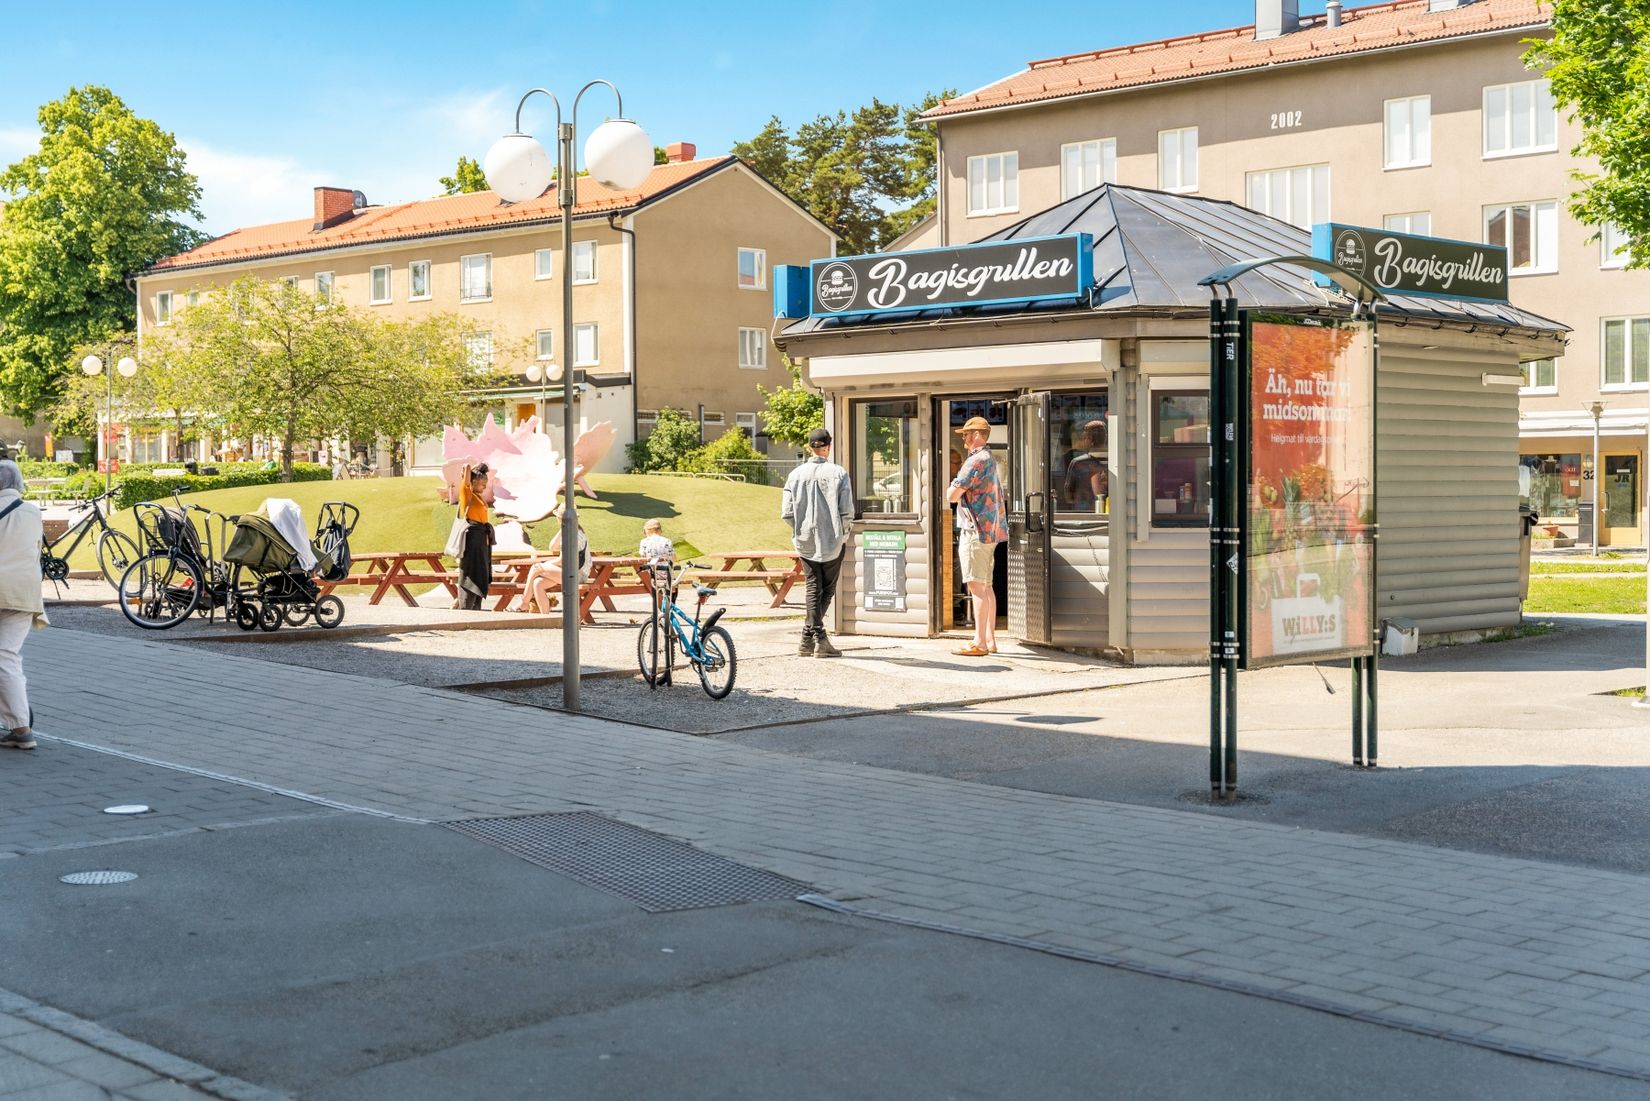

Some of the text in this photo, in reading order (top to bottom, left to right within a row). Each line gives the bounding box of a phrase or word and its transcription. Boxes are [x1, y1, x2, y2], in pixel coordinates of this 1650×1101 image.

[1271, 110, 1302, 129] 2002
[1374, 236, 1503, 290] Bagisgrillen
[867, 247, 1073, 309] Bagisgrillen
[1265, 368, 1291, 397] Äh,
[1294, 378, 1313, 396] nu
[1614, 474, 1630, 483] JR
